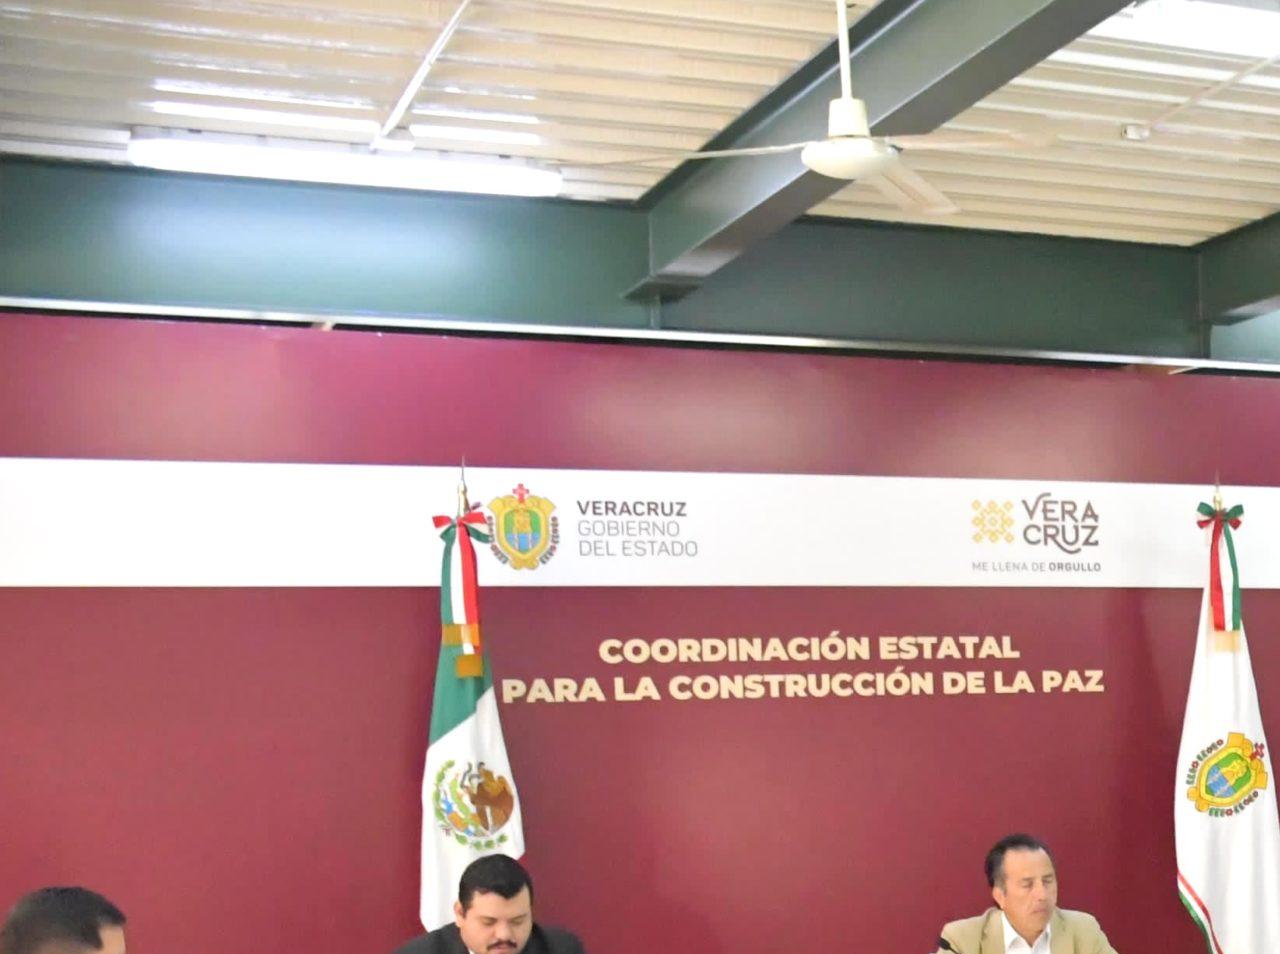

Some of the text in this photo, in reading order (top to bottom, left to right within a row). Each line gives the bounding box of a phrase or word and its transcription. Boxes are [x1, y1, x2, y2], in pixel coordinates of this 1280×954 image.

[577, 500, 687, 517] VERACRUZ
[1021, 491, 1099, 523] VERA
[577, 519, 680, 537] GOBIERNO
[1022, 523, 1099, 555] CRUZ
[578, 540, 698, 557] DEL ESTADO
[971, 561, 1101, 572] ME LLENA DE ORGULLO
[598, 630, 1021, 664] COORDINACIÓN ESTATAL
[502, 666, 1105, 703] PARA LA CONSTRUCCIÓN DE LA PAZ
